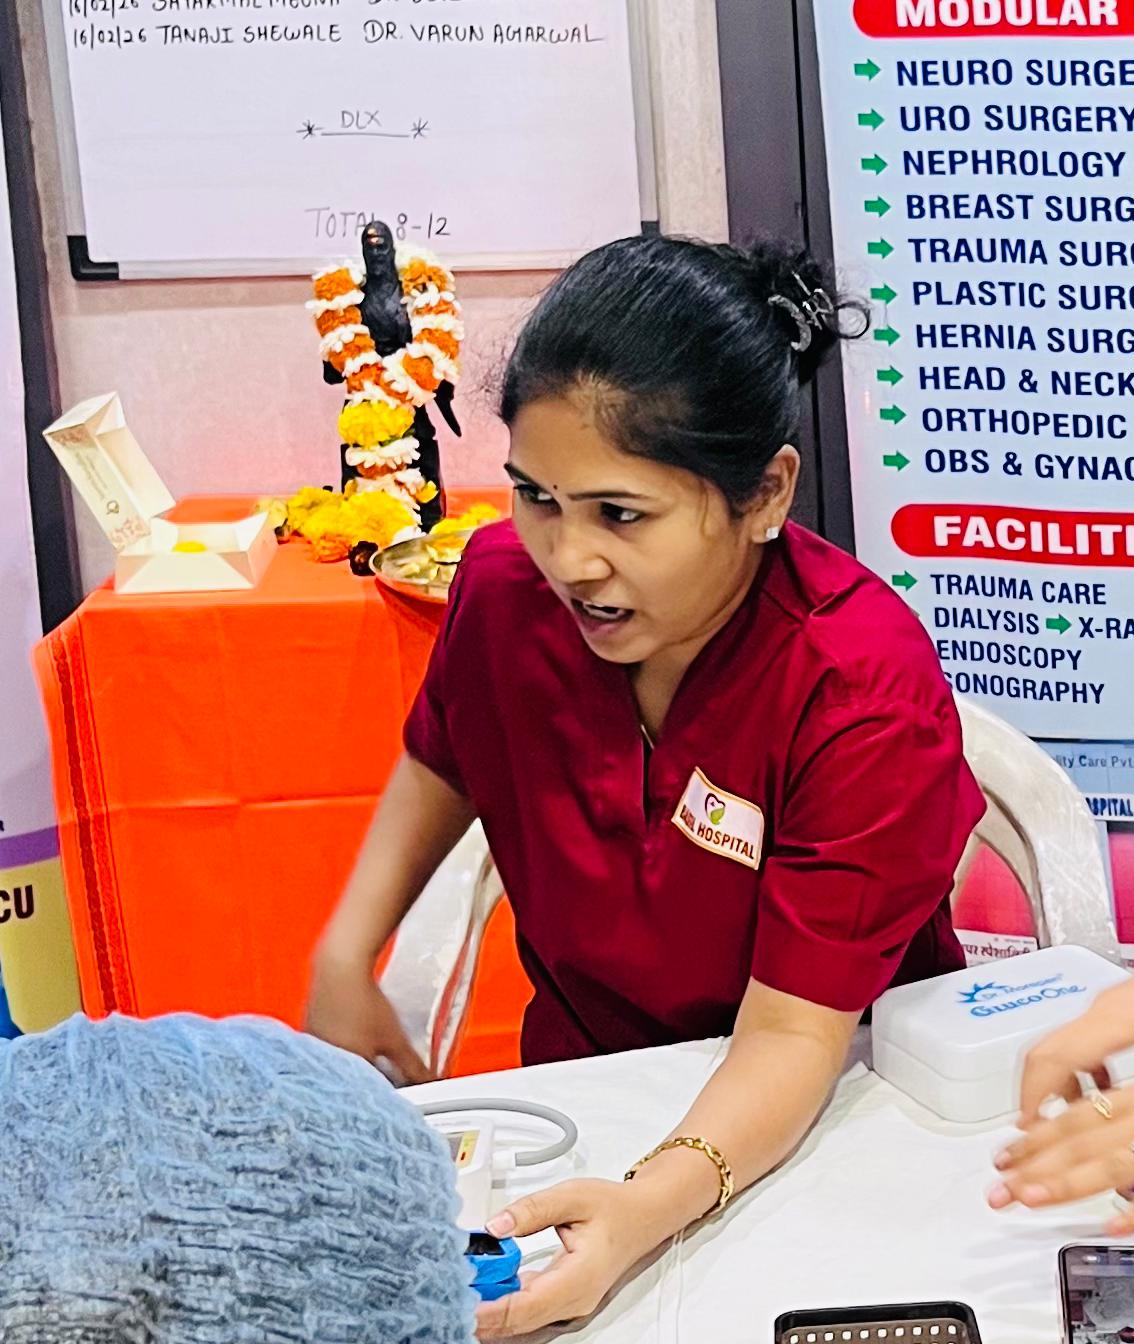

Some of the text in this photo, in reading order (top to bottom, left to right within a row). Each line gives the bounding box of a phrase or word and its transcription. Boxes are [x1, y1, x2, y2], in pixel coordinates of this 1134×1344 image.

[156, 21, 485, 44] TANAJI SHEWALE VARUN
[897, 60, 1012, 87] NEURO
[899, 107, 971, 133] URO
[902, 150, 1127, 180] NEPHROLOGY
[906, 194, 1033, 221] BREAST
[909, 238, 1047, 266] TRAUMA
[913, 282, 1046, 309] PLASTIC
[916, 324, 1036, 351] HERNIA
[919, 366, 1006, 391] HEAD
[1018, 368, 1039, 394] &
[921, 407, 1127, 440] ORTHOPEDIC
[924, 448, 989, 474] OBS
[1002, 450, 1022, 475] &
[931, 573, 1106, 605] TRAUMA CARE
[934, 607, 1039, 635] DIALYSIS
[937, 640, 1081, 671] ENDOSCOPY
[1079, 755, 1107, 767] Care
[697, 822, 754, 859] HOSPITAL
